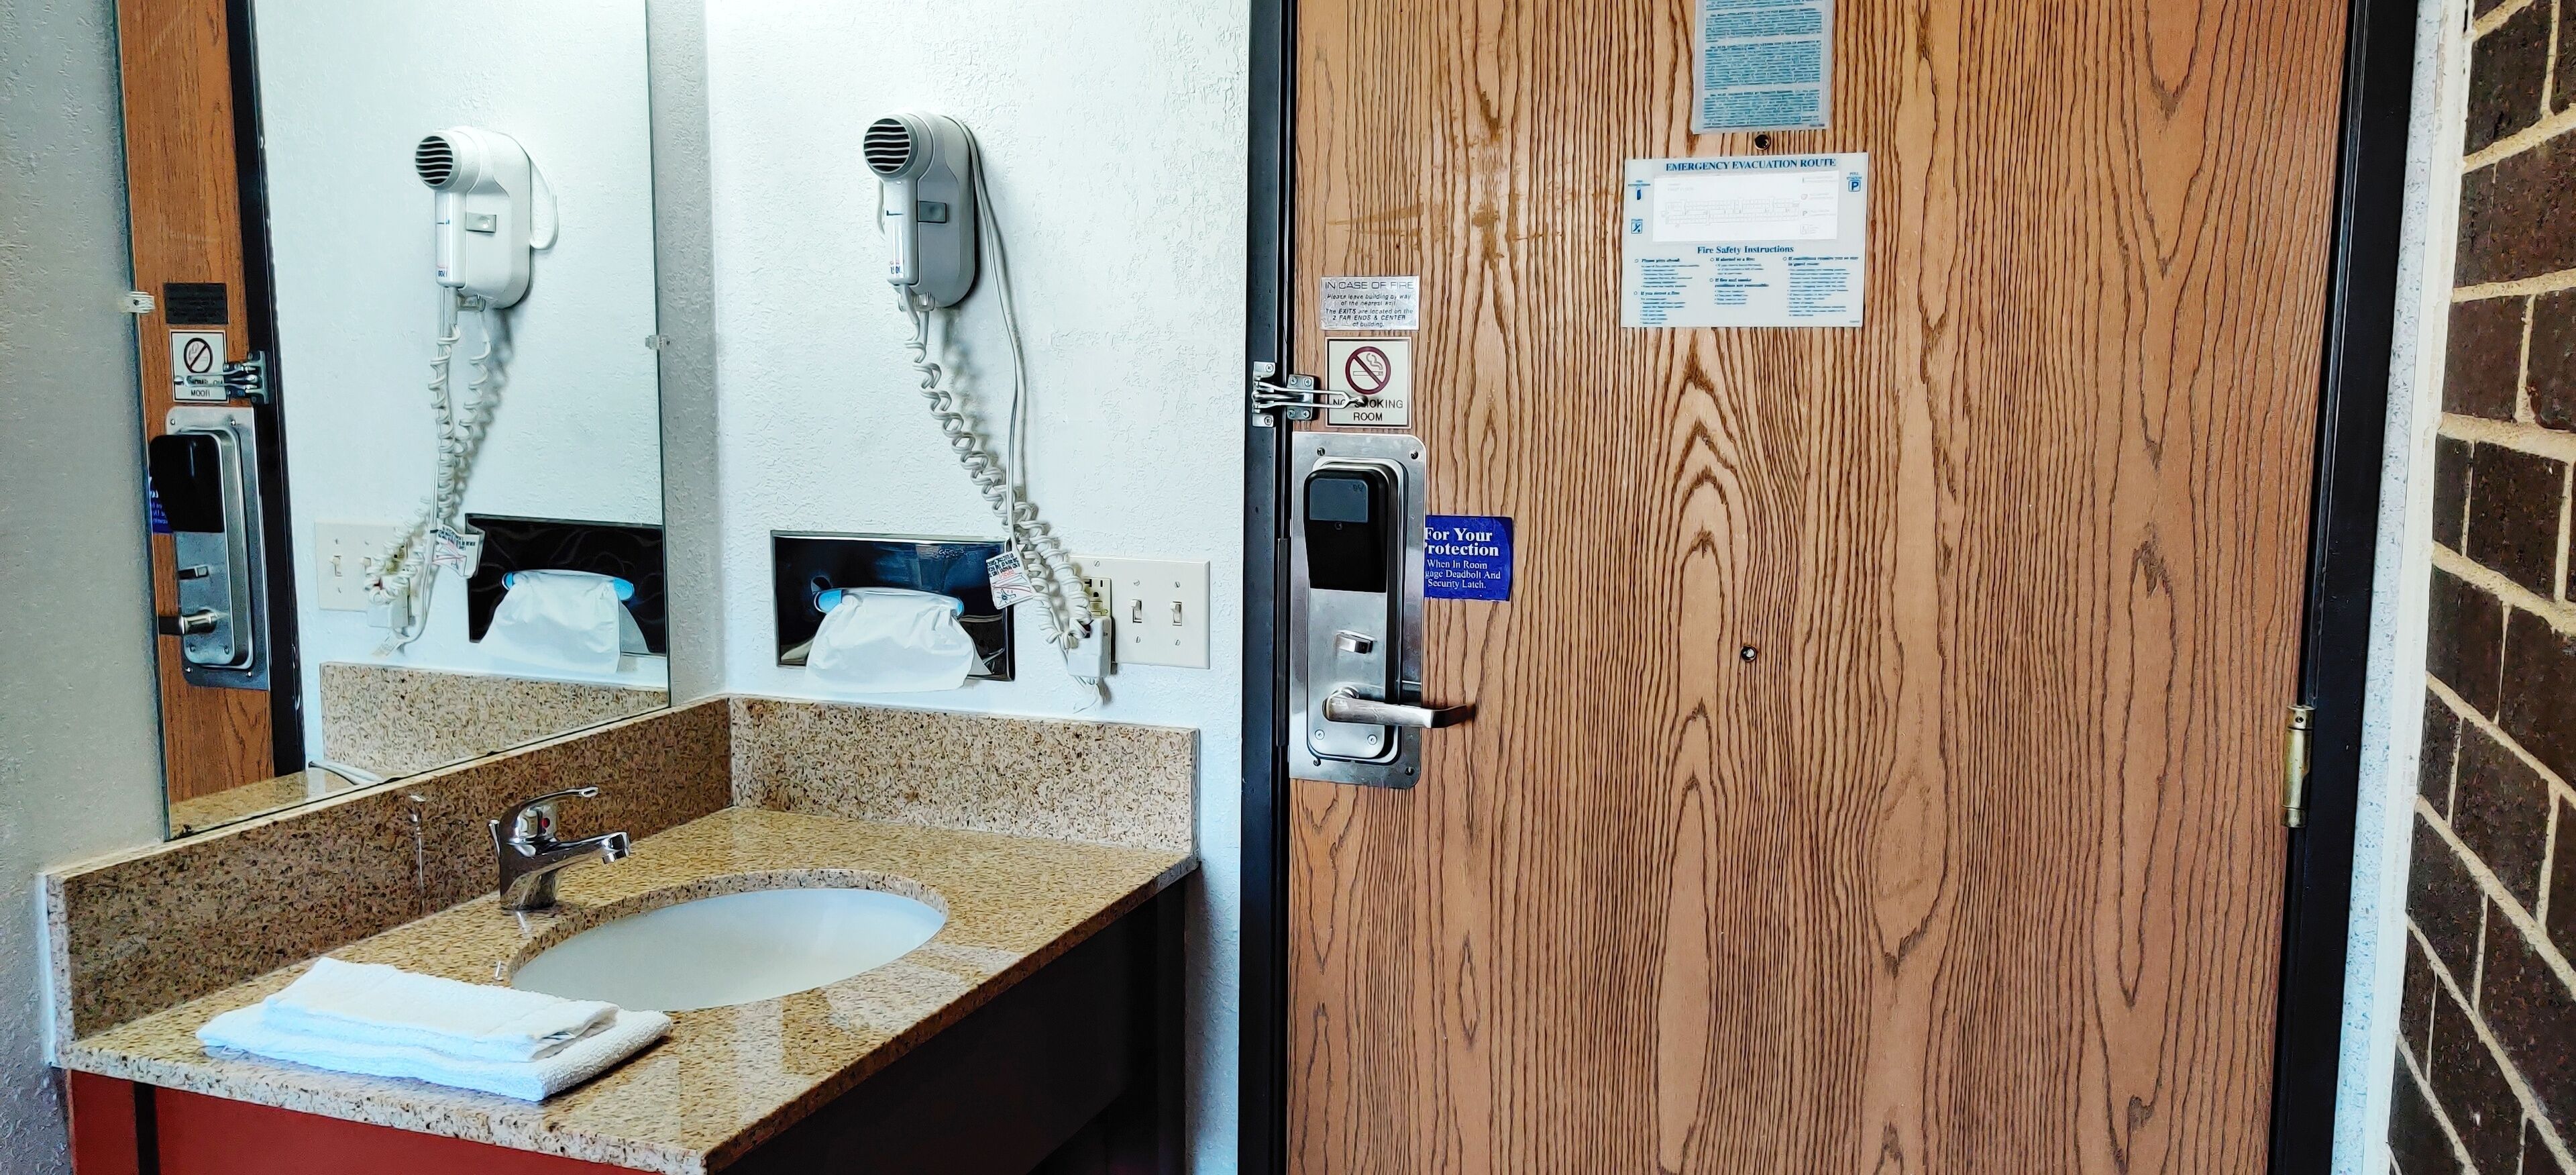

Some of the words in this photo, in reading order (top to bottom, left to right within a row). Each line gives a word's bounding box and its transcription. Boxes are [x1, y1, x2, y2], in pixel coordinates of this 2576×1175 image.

[1666, 161, 1730, 172] EMERGENCY
[1732, 159, 1797, 170] EVACUATION
[1800, 158, 1836, 168] ROUTE
[1697, 246, 1714, 254] Fire
[1716, 246, 1741, 255] Safety
[1744, 246, 1794, 254] Instructions
[1354, 399, 1403, 408] OKING
[1354, 412, 1383, 421] ROOM
[1425, 527, 1450, 541] For
[1453, 527, 1493, 542] Your
[1427, 559, 1450, 568] When
[1453, 560, 1460, 568] In
[1463, 560, 1487, 569] Room
[1446, 570, 1481, 579] Deadbolt
[1483, 571, 1501, 579] And
[1428, 579, 1460, 590] Security
[1462, 580, 1487, 589] Latch.
